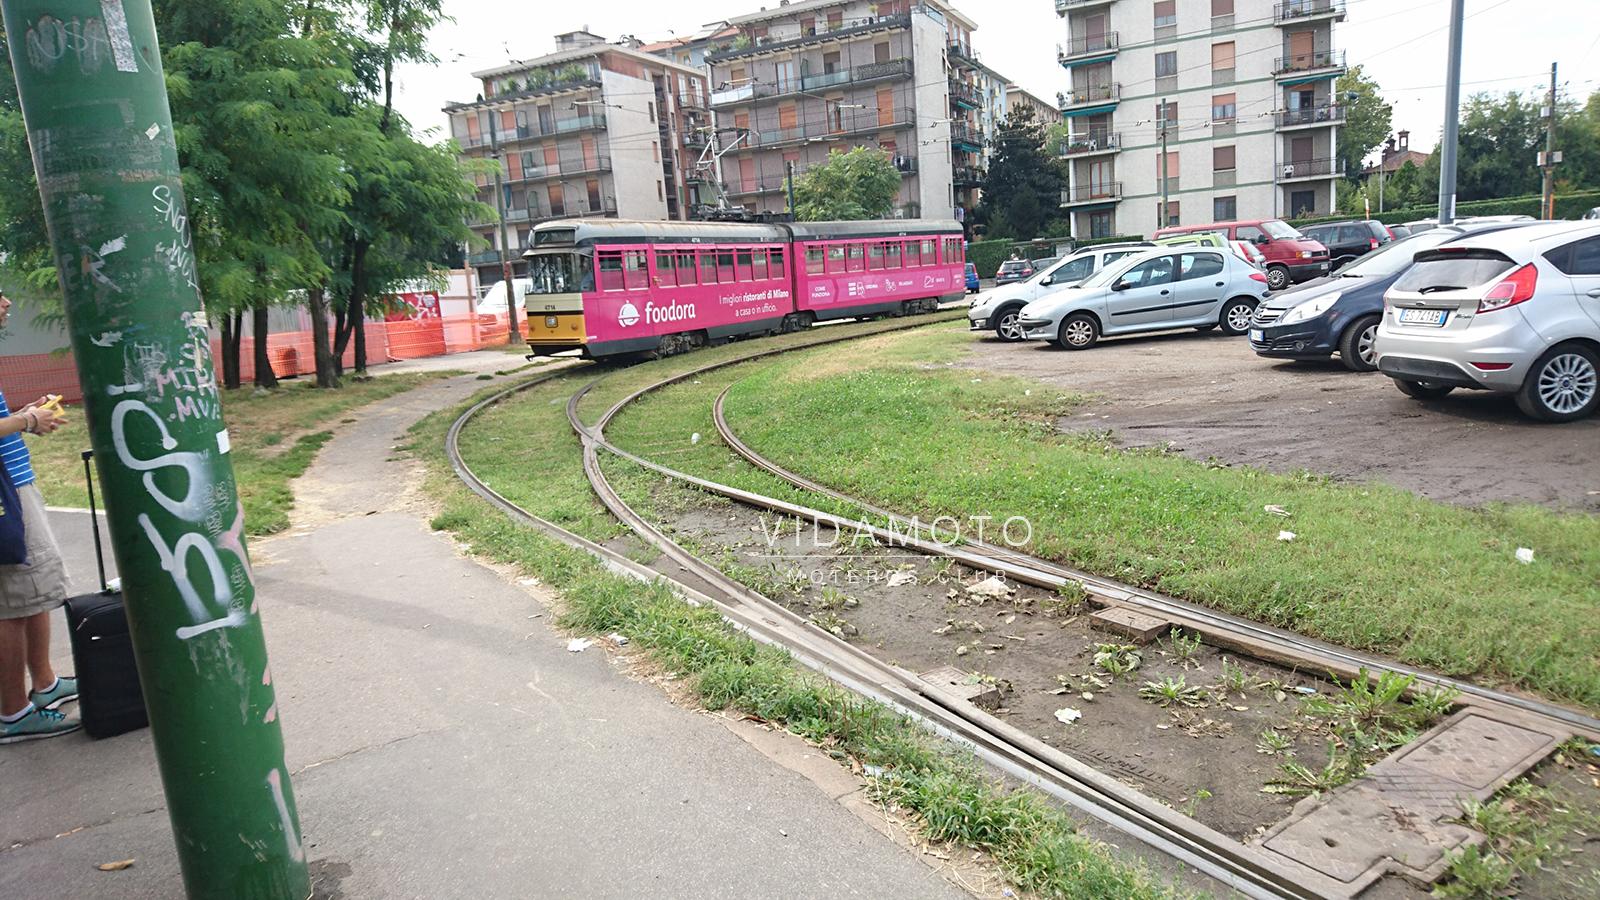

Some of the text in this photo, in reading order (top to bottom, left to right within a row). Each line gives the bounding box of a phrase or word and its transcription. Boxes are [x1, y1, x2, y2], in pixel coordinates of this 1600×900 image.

[722, 294, 743, 306] migliori
[743, 291, 767, 302] ristoranti
[767, 290, 772, 299] di
[773, 289, 789, 299] Milano
[645, 299, 696, 324] foodora
